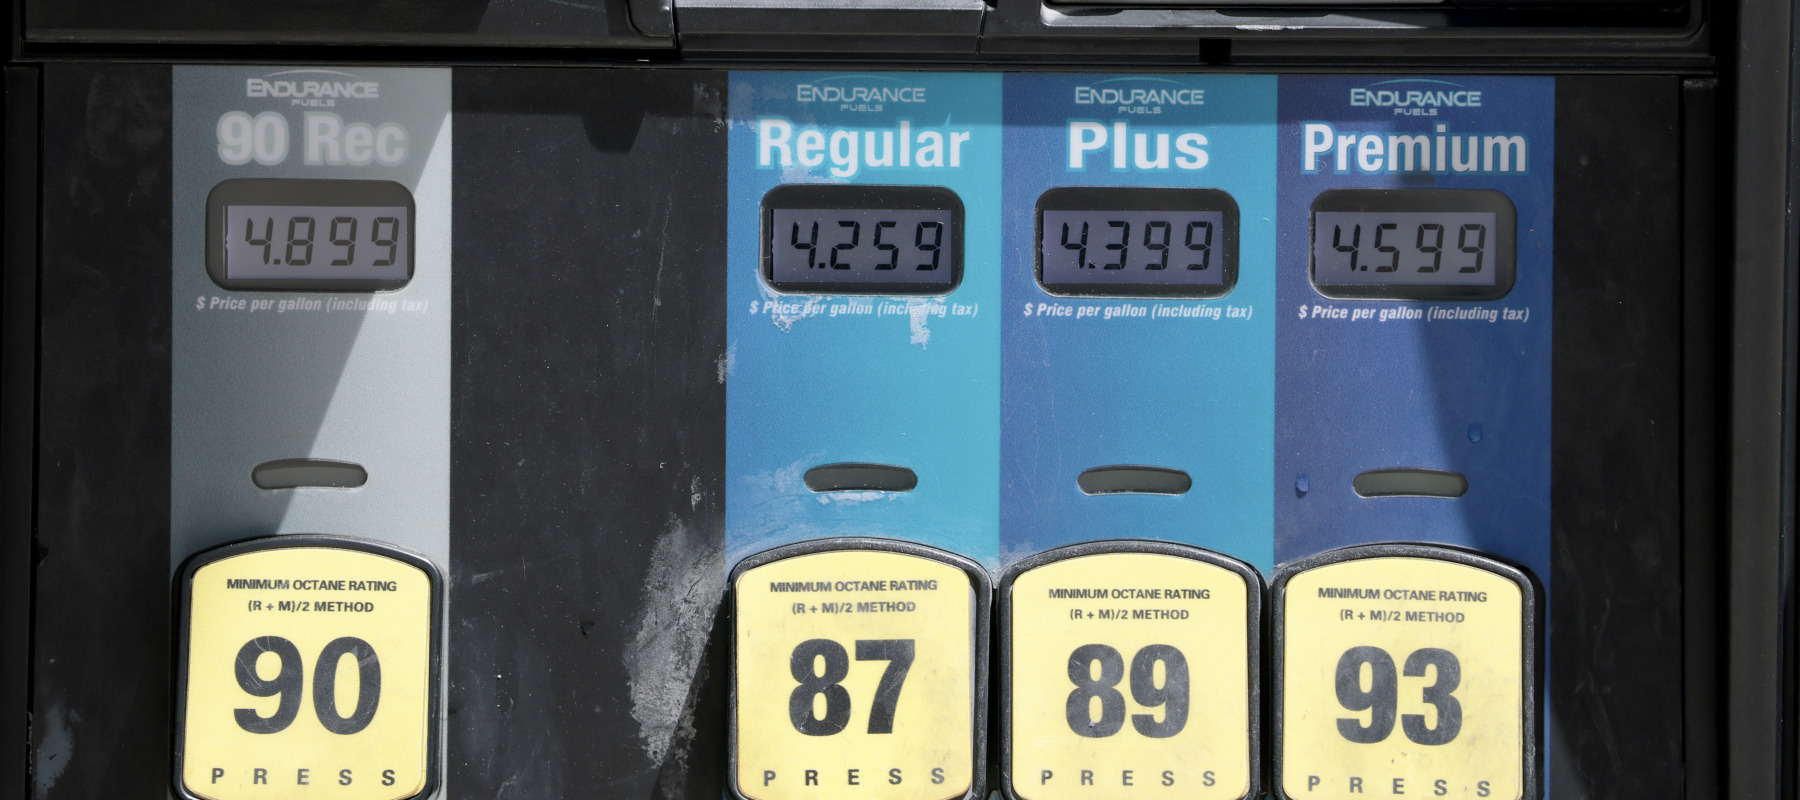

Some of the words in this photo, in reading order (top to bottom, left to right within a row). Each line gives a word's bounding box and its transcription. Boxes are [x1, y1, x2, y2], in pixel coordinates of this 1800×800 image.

[246, 79, 379, 98] ENDURANCE
[797, 85, 926, 102] ENDURANCE
[1075, 87, 1205, 105] ENDURANCE
[1350, 88, 1482, 107] ENDURANCE
[291, 99, 335, 107] FUELS
[841, 104, 883, 112] FUELS
[219, 113, 288, 164] 90
[305, 113, 407, 164] Rec
[1069, 122, 1209, 169] Plus
[1305, 123, 1526, 172] Premium
[759, 119, 970, 177] Regular
[245, 217, 400, 266] 4.899
[791, 221, 943, 270] 4.259
[1061, 221, 1213, 270] 4.399
[1333, 223, 1486, 273] 4.599
[196, 296, 205, 311] $
[210, 296, 246, 310] Price
[250, 299, 274, 312] per
[278, 298, 322, 312] gallon
[326, 298, 397, 313] (including
[401, 299, 428, 313] tax)
[750, 300, 759, 315] $
[763, 301, 799, 315] Price
[803, 303, 826, 317] per
[829, 302, 873, 317] gallon
[878, 302, 947, 317] (incling
[952, 303, 979, 318] tax)
[1023, 303, 1033, 317] $
[1036, 304, 1073, 317] Price
[1077, 306, 1101, 318] per
[1104, 304, 1147, 319] gallon
[1151, 304, 1221, 320] (including
[1226, 305, 1253, 320] tax)
[1298, 305, 1308, 319] $
[1312, 306, 1348, 319] Price
[1352, 308, 1376, 320] per
[1379, 306, 1423, 321] gallon
[1427, 306, 1498, 323] (including
[1502, 307, 1530, 323] tax)
[227, 579, 290, 590] MINIMUM
[293, 580, 346, 591] OCTANE
[349, 580, 397, 592] RATING
[770, 581, 832, 592] MINIMUM
[835, 581, 887, 591] OCTANE
[890, 580, 937, 591] RATING
[1049, 589, 1109, 599] MINIMUM
[1111, 589, 1162, 599] OCTANE
[1164, 589, 1210, 600] RATING
[1318, 588, 1380, 599] MINIMUM
[1383, 589, 1436, 601] OCTANE
[1439, 591, 1487, 602] RATING
[314, 602, 374, 612] METHOD
[857, 602, 916, 613] METHOD
[1132, 610, 1189, 620] METHOD
[1405, 611, 1465, 623] METHOD
[234, 635, 381, 735] 90
[789, 639, 915, 736] 87
[1066, 644, 1190, 738] 89
[1335, 646, 1463, 745] 93
[211, 767, 396, 786] PRESS
[763, 768, 945, 786] PRESS
[1041, 770, 1216, 787] PRESS
[1308, 775, 1491, 798] PRESS
